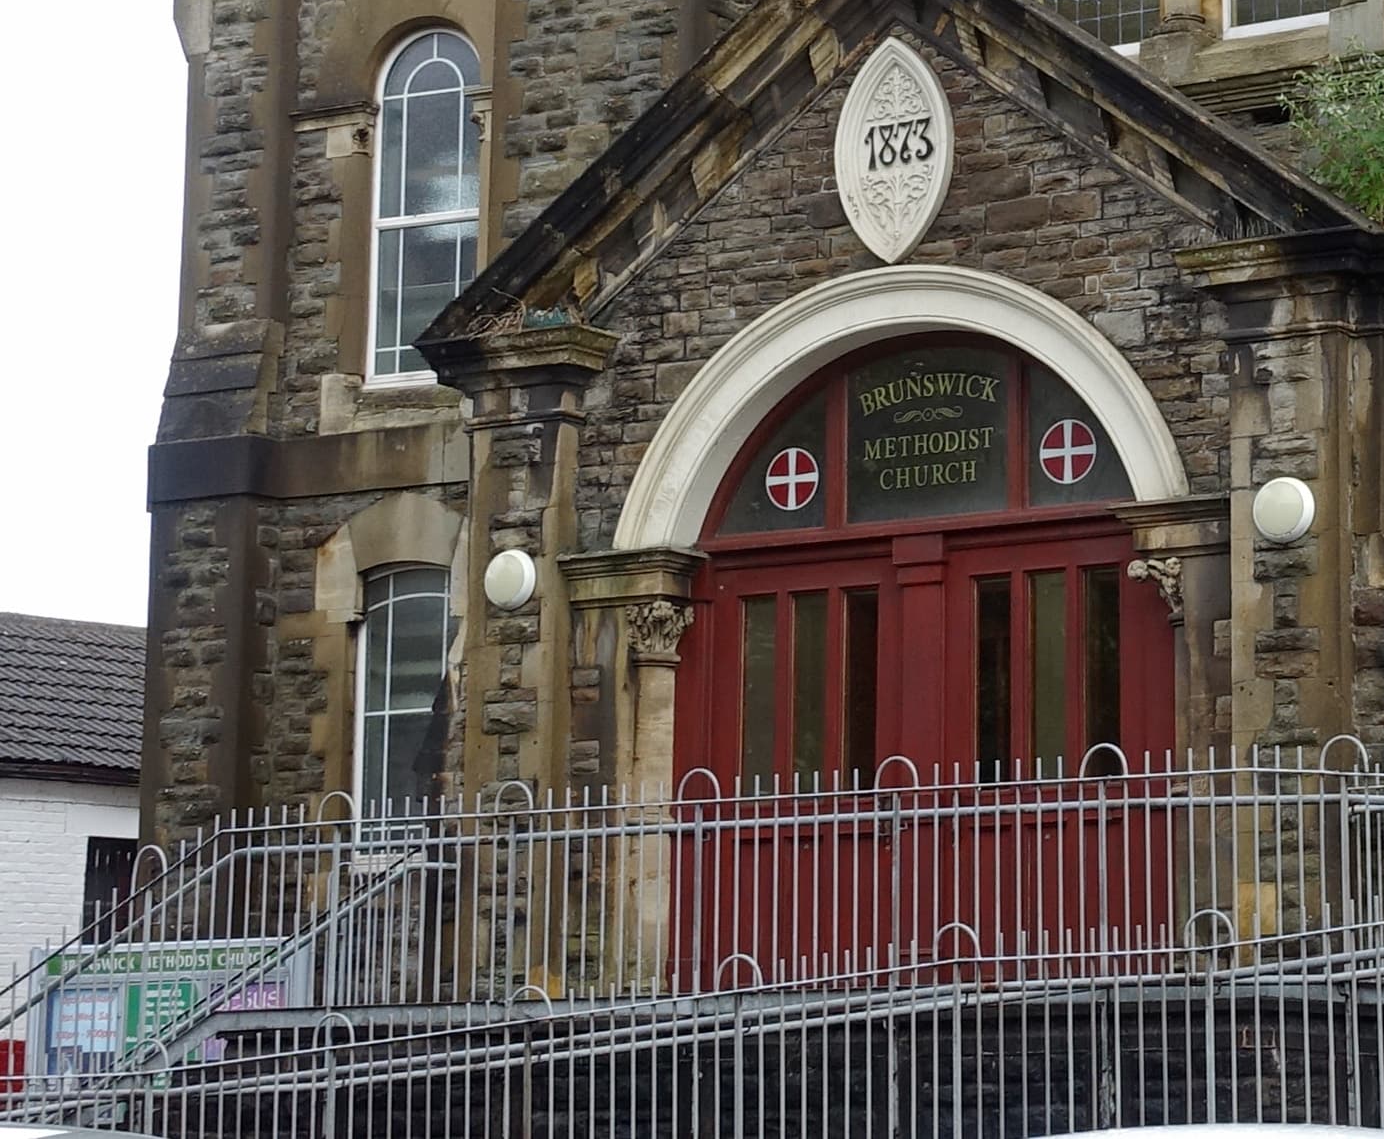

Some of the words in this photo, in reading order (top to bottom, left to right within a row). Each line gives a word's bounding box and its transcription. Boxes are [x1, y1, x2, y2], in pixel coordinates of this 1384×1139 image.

[864, 116, 935, 171] 1873
[858, 372, 1001, 417] BRUNSWICK
[864, 426, 994, 461] METHODIST
[879, 460, 977, 490] CHURCH
